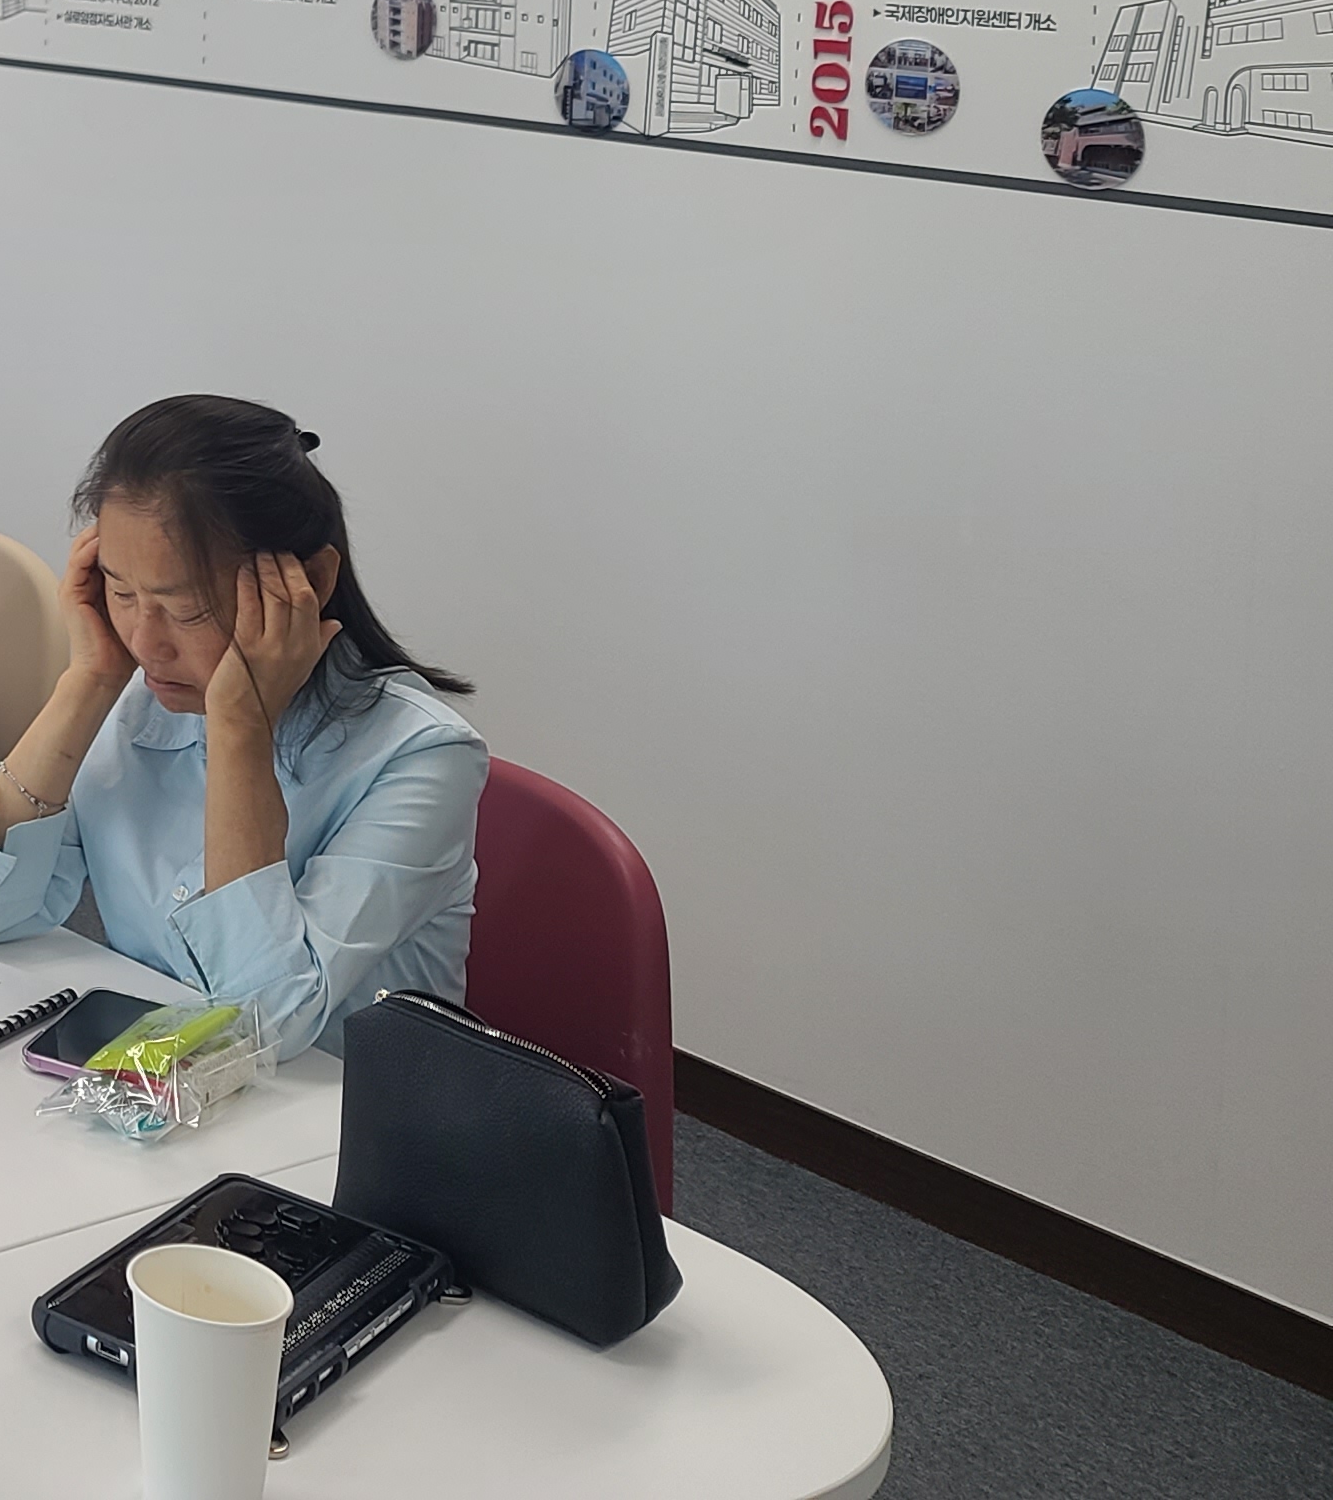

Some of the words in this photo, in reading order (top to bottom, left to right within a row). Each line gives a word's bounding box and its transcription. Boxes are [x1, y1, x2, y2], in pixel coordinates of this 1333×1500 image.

[134, 17, 152, 31] 개소
[884, 3, 1023, 31] 국제장애인지원센터
[1024, 11, 1058, 33] 개소
[809, 0, 855, 141] 2015
